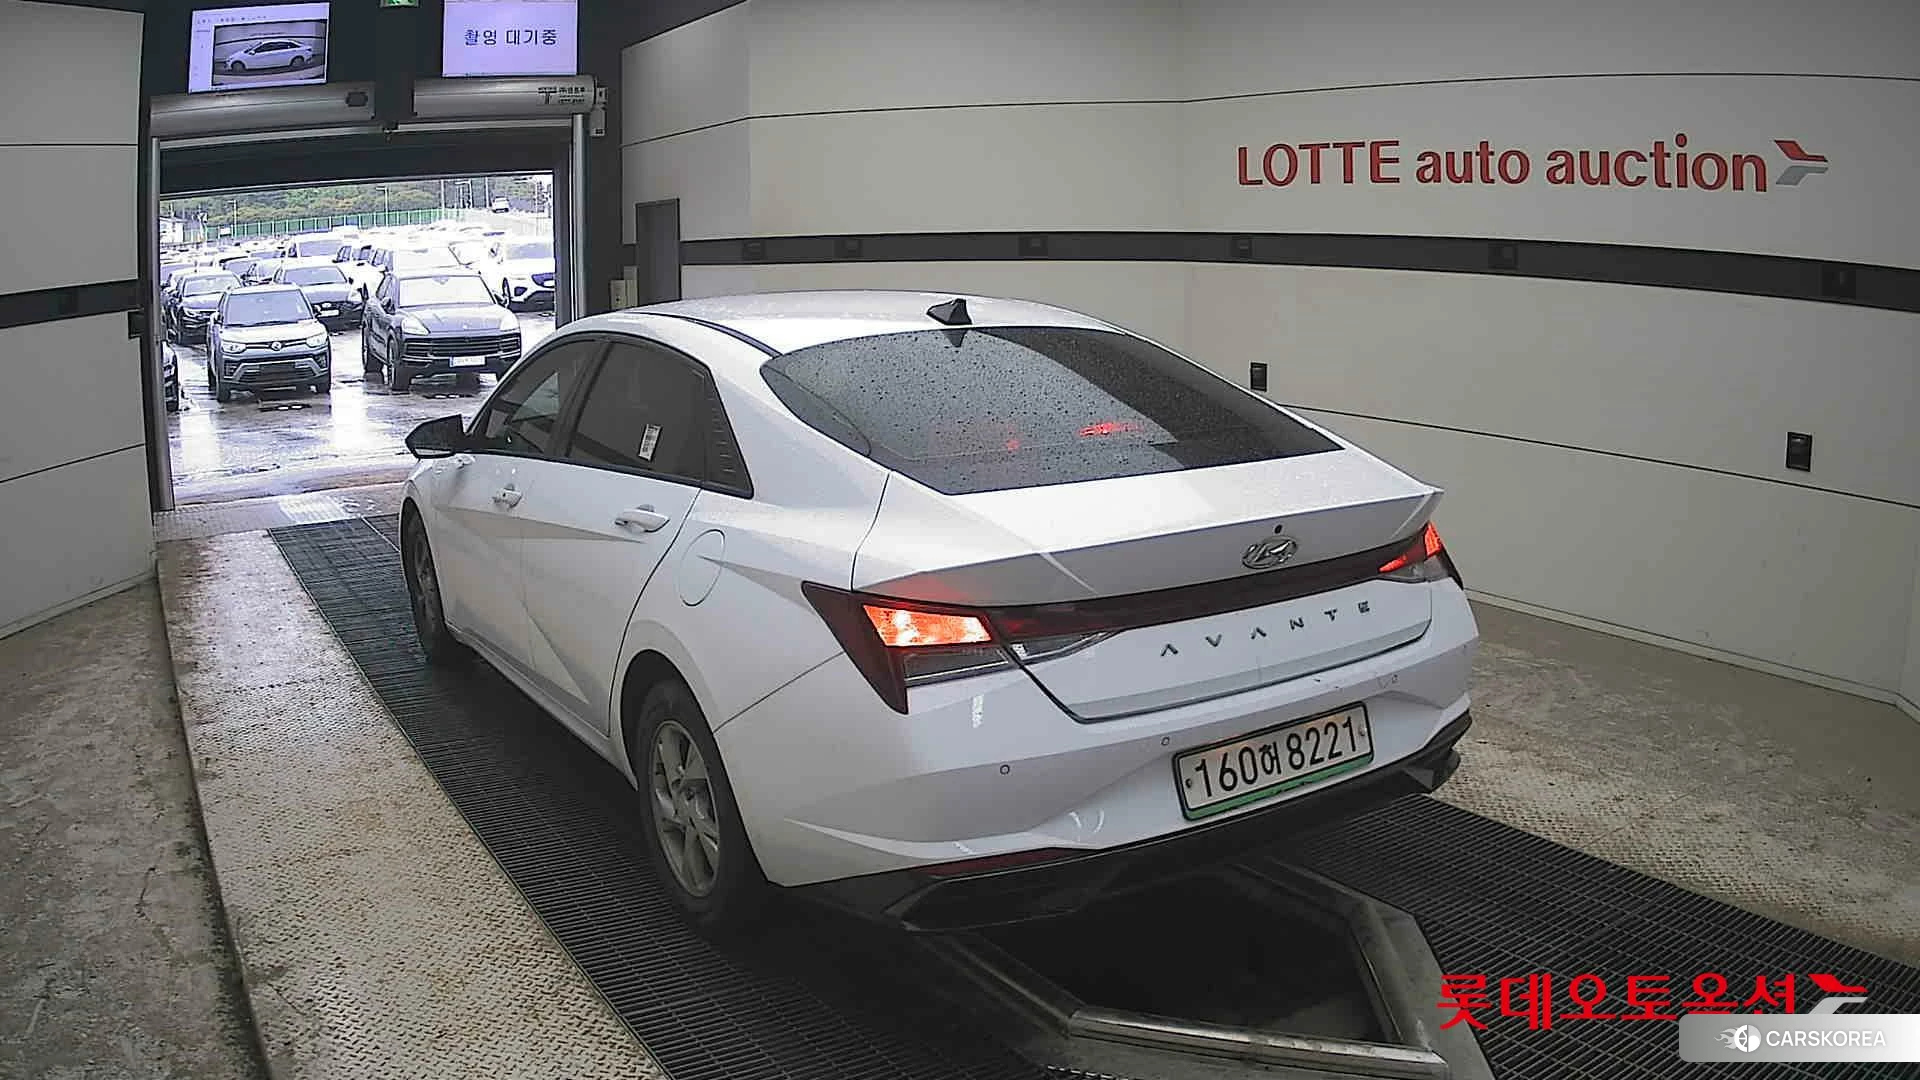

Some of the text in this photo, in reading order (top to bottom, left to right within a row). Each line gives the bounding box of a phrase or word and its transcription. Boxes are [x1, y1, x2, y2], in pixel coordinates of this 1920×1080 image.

[465, 29, 557, 46] 촬영 대기중
[1237, 132, 1767, 193] LOTTE auto auction
[1160, 600, 1371, 657] AVANTE
